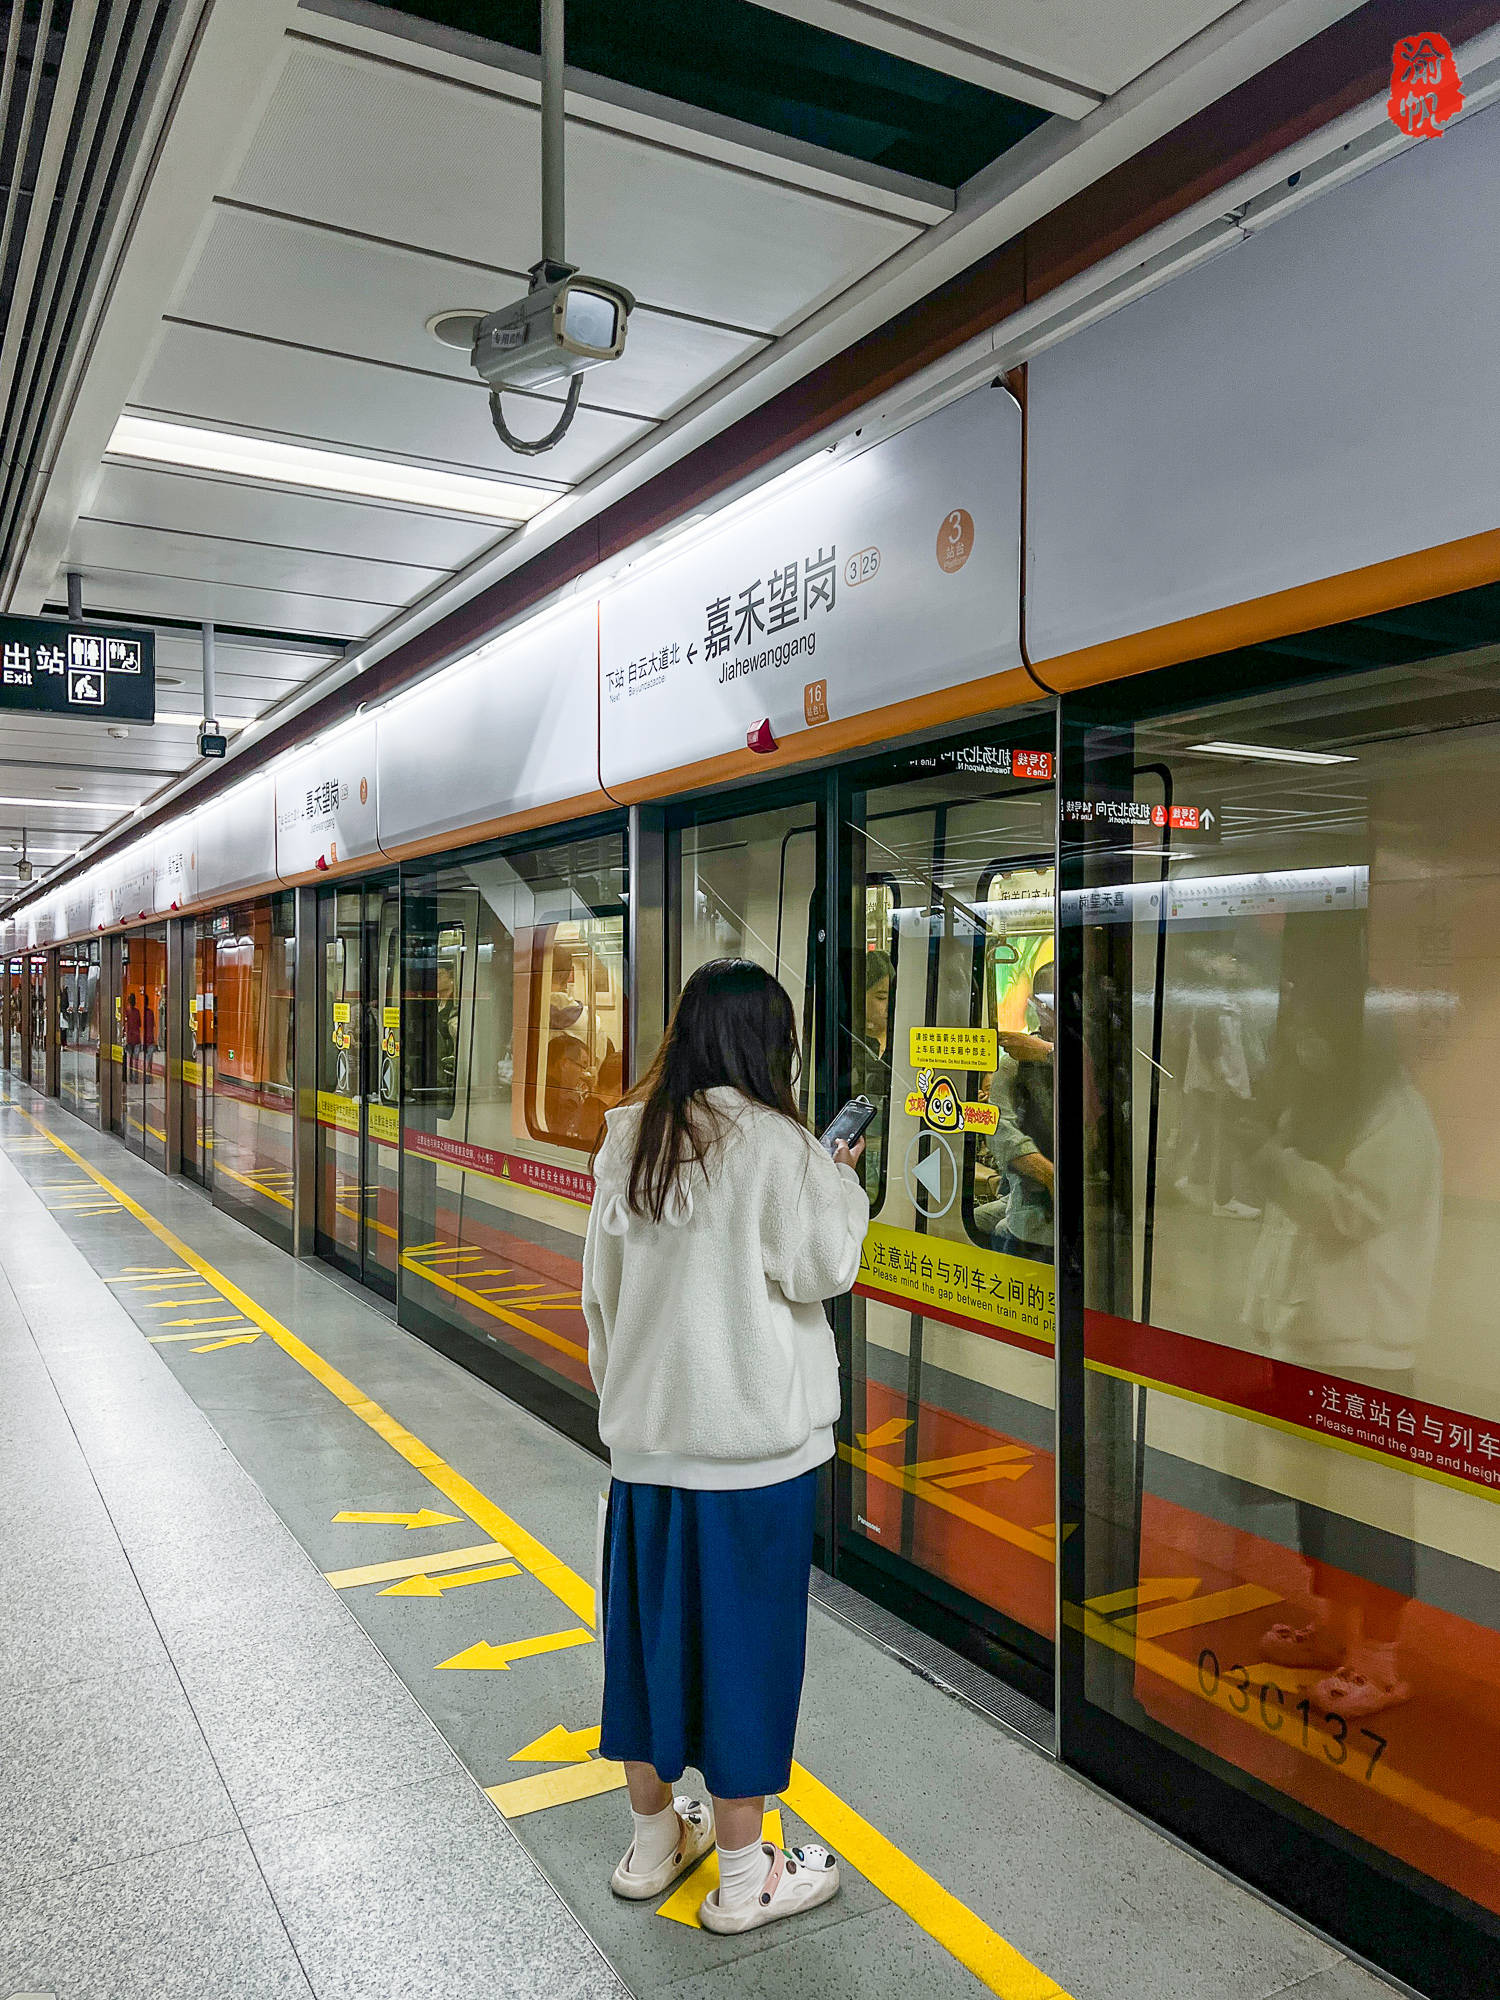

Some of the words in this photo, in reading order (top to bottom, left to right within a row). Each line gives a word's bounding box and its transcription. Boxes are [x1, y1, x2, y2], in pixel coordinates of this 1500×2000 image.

[948, 511, 962, 544] 3
[850, 562, 857, 580] 3
[862, 552, 878, 575] 25
[945, 542, 965, 561] 站台
[704, 544, 837, 662] 嘉禾望岗
[3, 642, 66, 675] 出站
[718, 632, 817, 684] Jiahewanggang
[3, 670, 33, 686] Exit
[808, 684, 822, 704] 16
[873, 1267, 898, 1283] Please
[900, 1277, 919, 1290] mind
[922, 1282, 935, 1295] the
[938, 1288, 953, 1301] gap
[957, 1292, 993, 1312] between
[997, 1303, 1017, 1319] train
[1021, 1312, 1039, 1326] and
[1321, 1385, 1500, 1461] 注意站台与列车
[1315, 1413, 1355, 1437] Please
[1356, 1427, 1385, 1446] mind
[1388, 1437, 1407, 1453] the
[1410, 1445, 1433, 1462] gap
[1436, 1453, 1461, 1471] and
